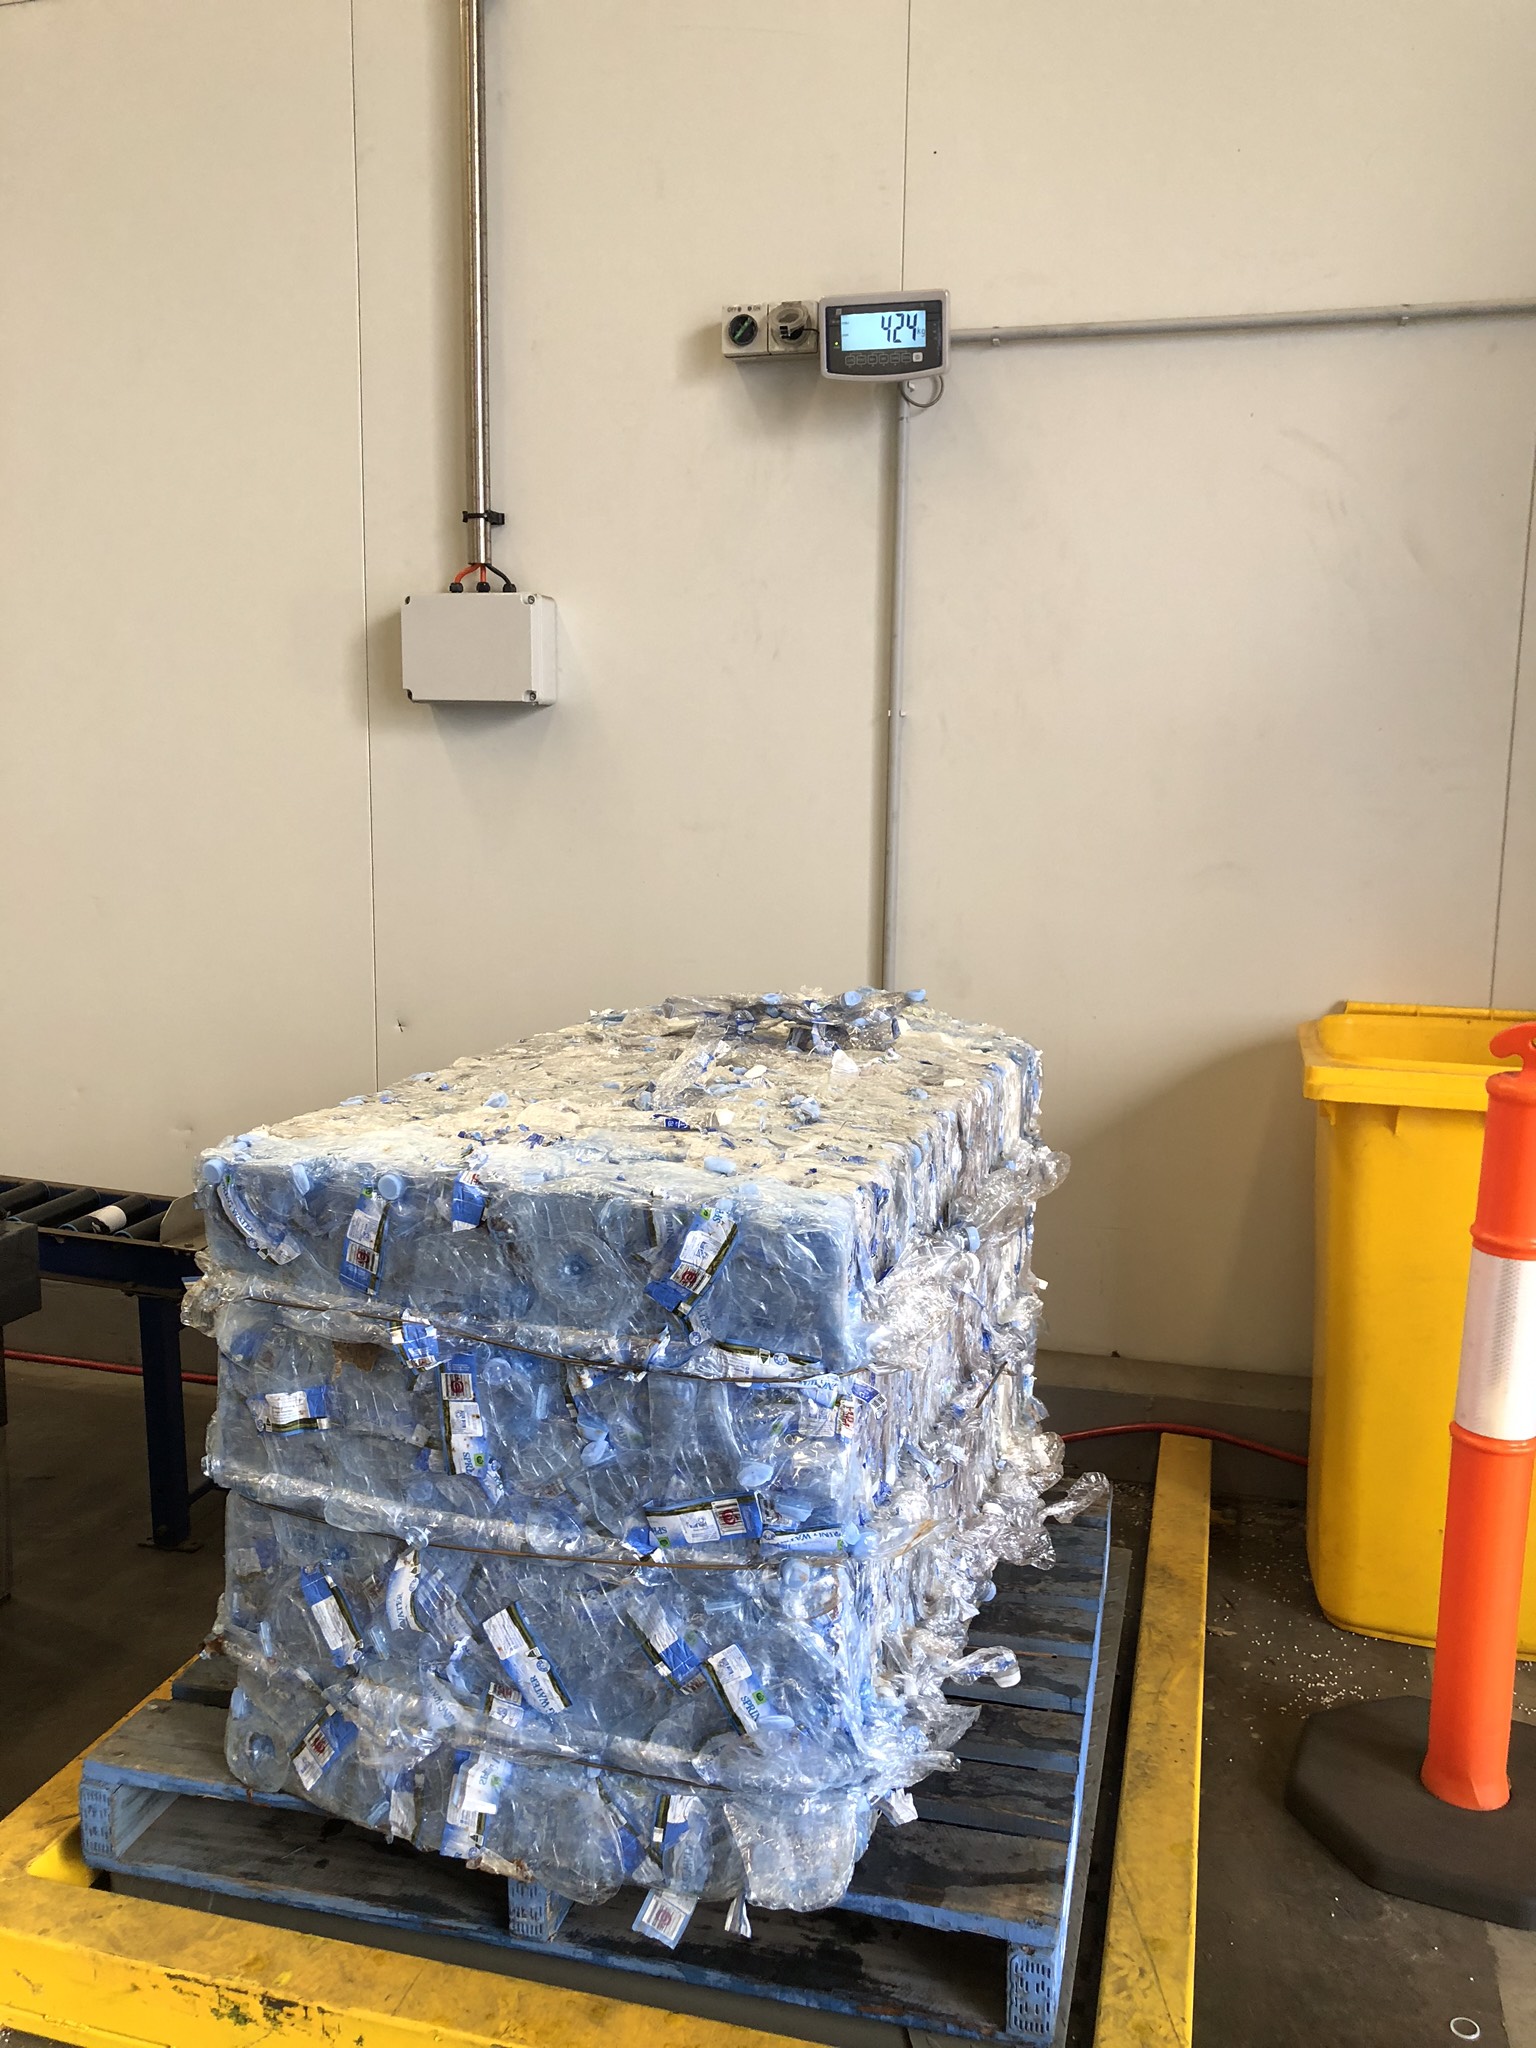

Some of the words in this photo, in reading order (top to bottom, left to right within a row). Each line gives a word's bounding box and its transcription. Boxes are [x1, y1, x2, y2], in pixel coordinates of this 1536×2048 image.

[881, 313, 918, 343] 424
[917, 327, 926, 338] kg
[529, 1674, 550, 1708] WATER
